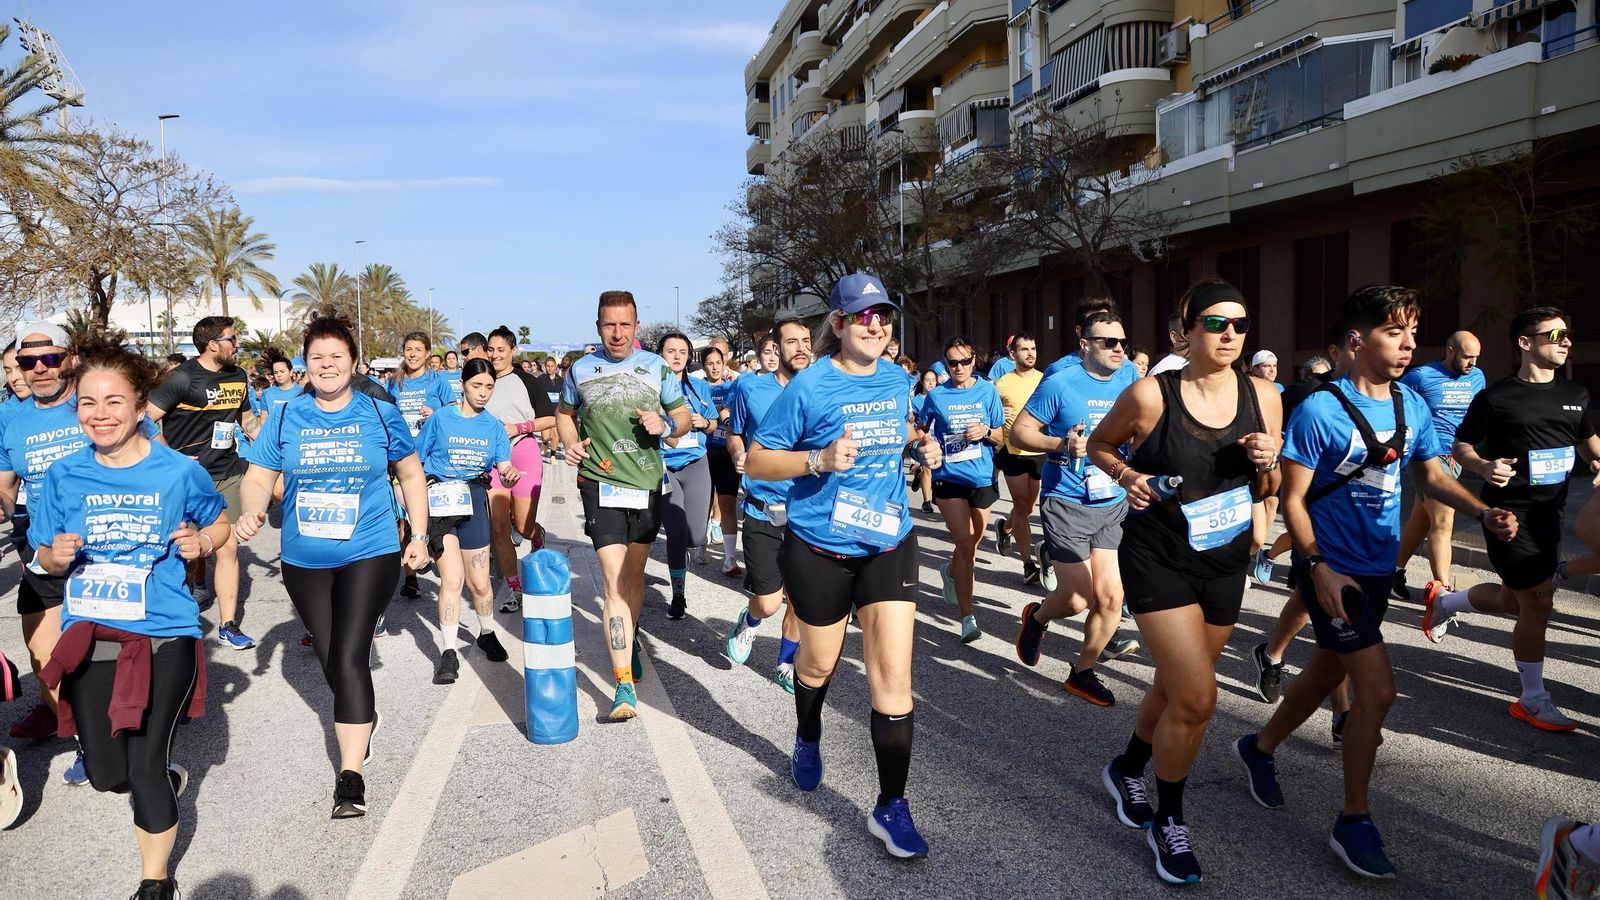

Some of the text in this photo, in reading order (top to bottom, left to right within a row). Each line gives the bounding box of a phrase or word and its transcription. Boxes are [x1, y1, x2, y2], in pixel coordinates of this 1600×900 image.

[842, 398, 897, 415] mayoral
[948, 401, 983, 412] mayoral
[1087, 400, 1116, 409] mayo
[26, 424, 84, 446] mayoral
[300, 424, 360, 437] mayoral
[448, 436, 489, 446] mayoral
[855, 436, 894, 448] RIENDS
[1544, 460, 1566, 471] 954
[85, 492, 161, 508] mayoral
[437, 493, 465, 505] 209
[85, 512, 159, 526] RUNNING
[308, 507, 346, 522] 2775
[850, 508, 883, 528] 449
[1208, 508, 1238, 529] 582
[92, 522, 152, 534] MAKES
[87, 530, 148, 544] FRIENDS
[81, 579, 129, 600] 2776
